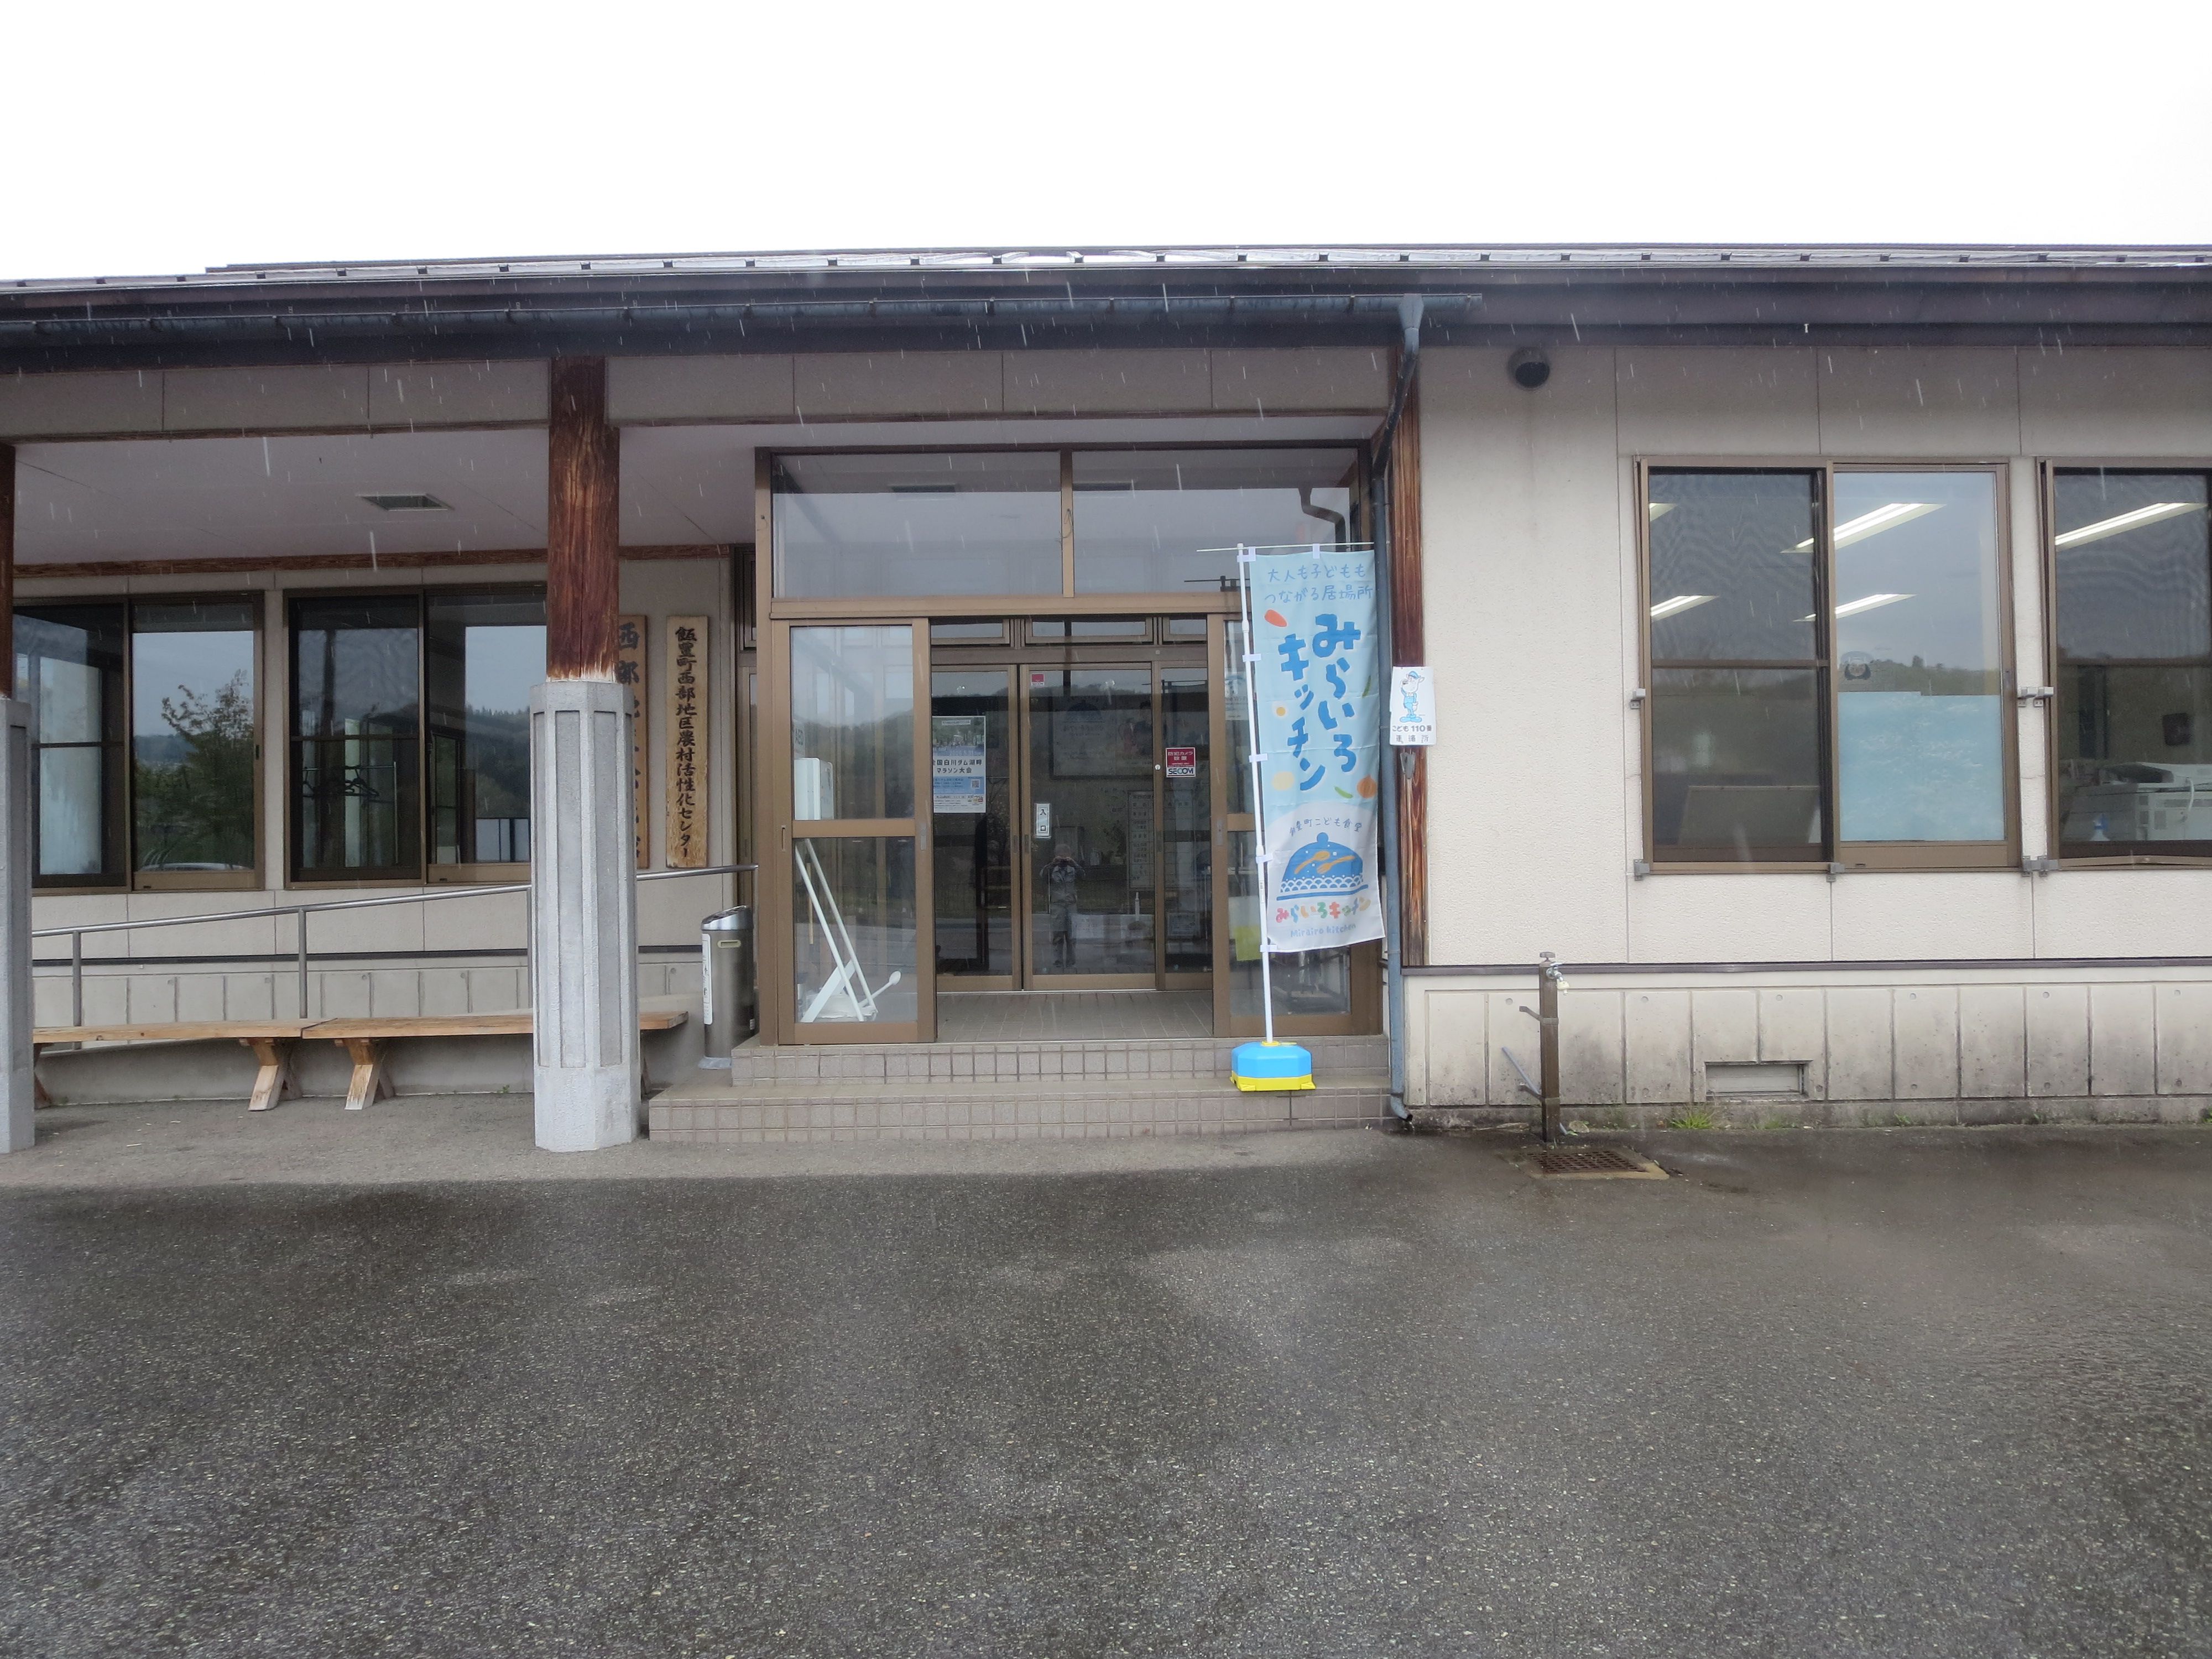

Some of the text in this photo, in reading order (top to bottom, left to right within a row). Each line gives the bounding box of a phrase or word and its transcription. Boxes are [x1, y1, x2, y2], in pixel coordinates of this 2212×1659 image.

[1267, 563, 1367, 582] 大人も子どもも
[1264, 585, 1373, 604] つながる居場所
[1312, 613, 1361, 773] みらいろ
[1277, 633, 1326, 791] キッチン
[675, 627, 697, 858] 飯豊町西部地区農村活性化センター
[1040, 808, 1047, 831] 入口
[1276, 898, 1370, 923] みらいろキッチン
[1290, 923, 1357, 938] Mirairo kitchen
